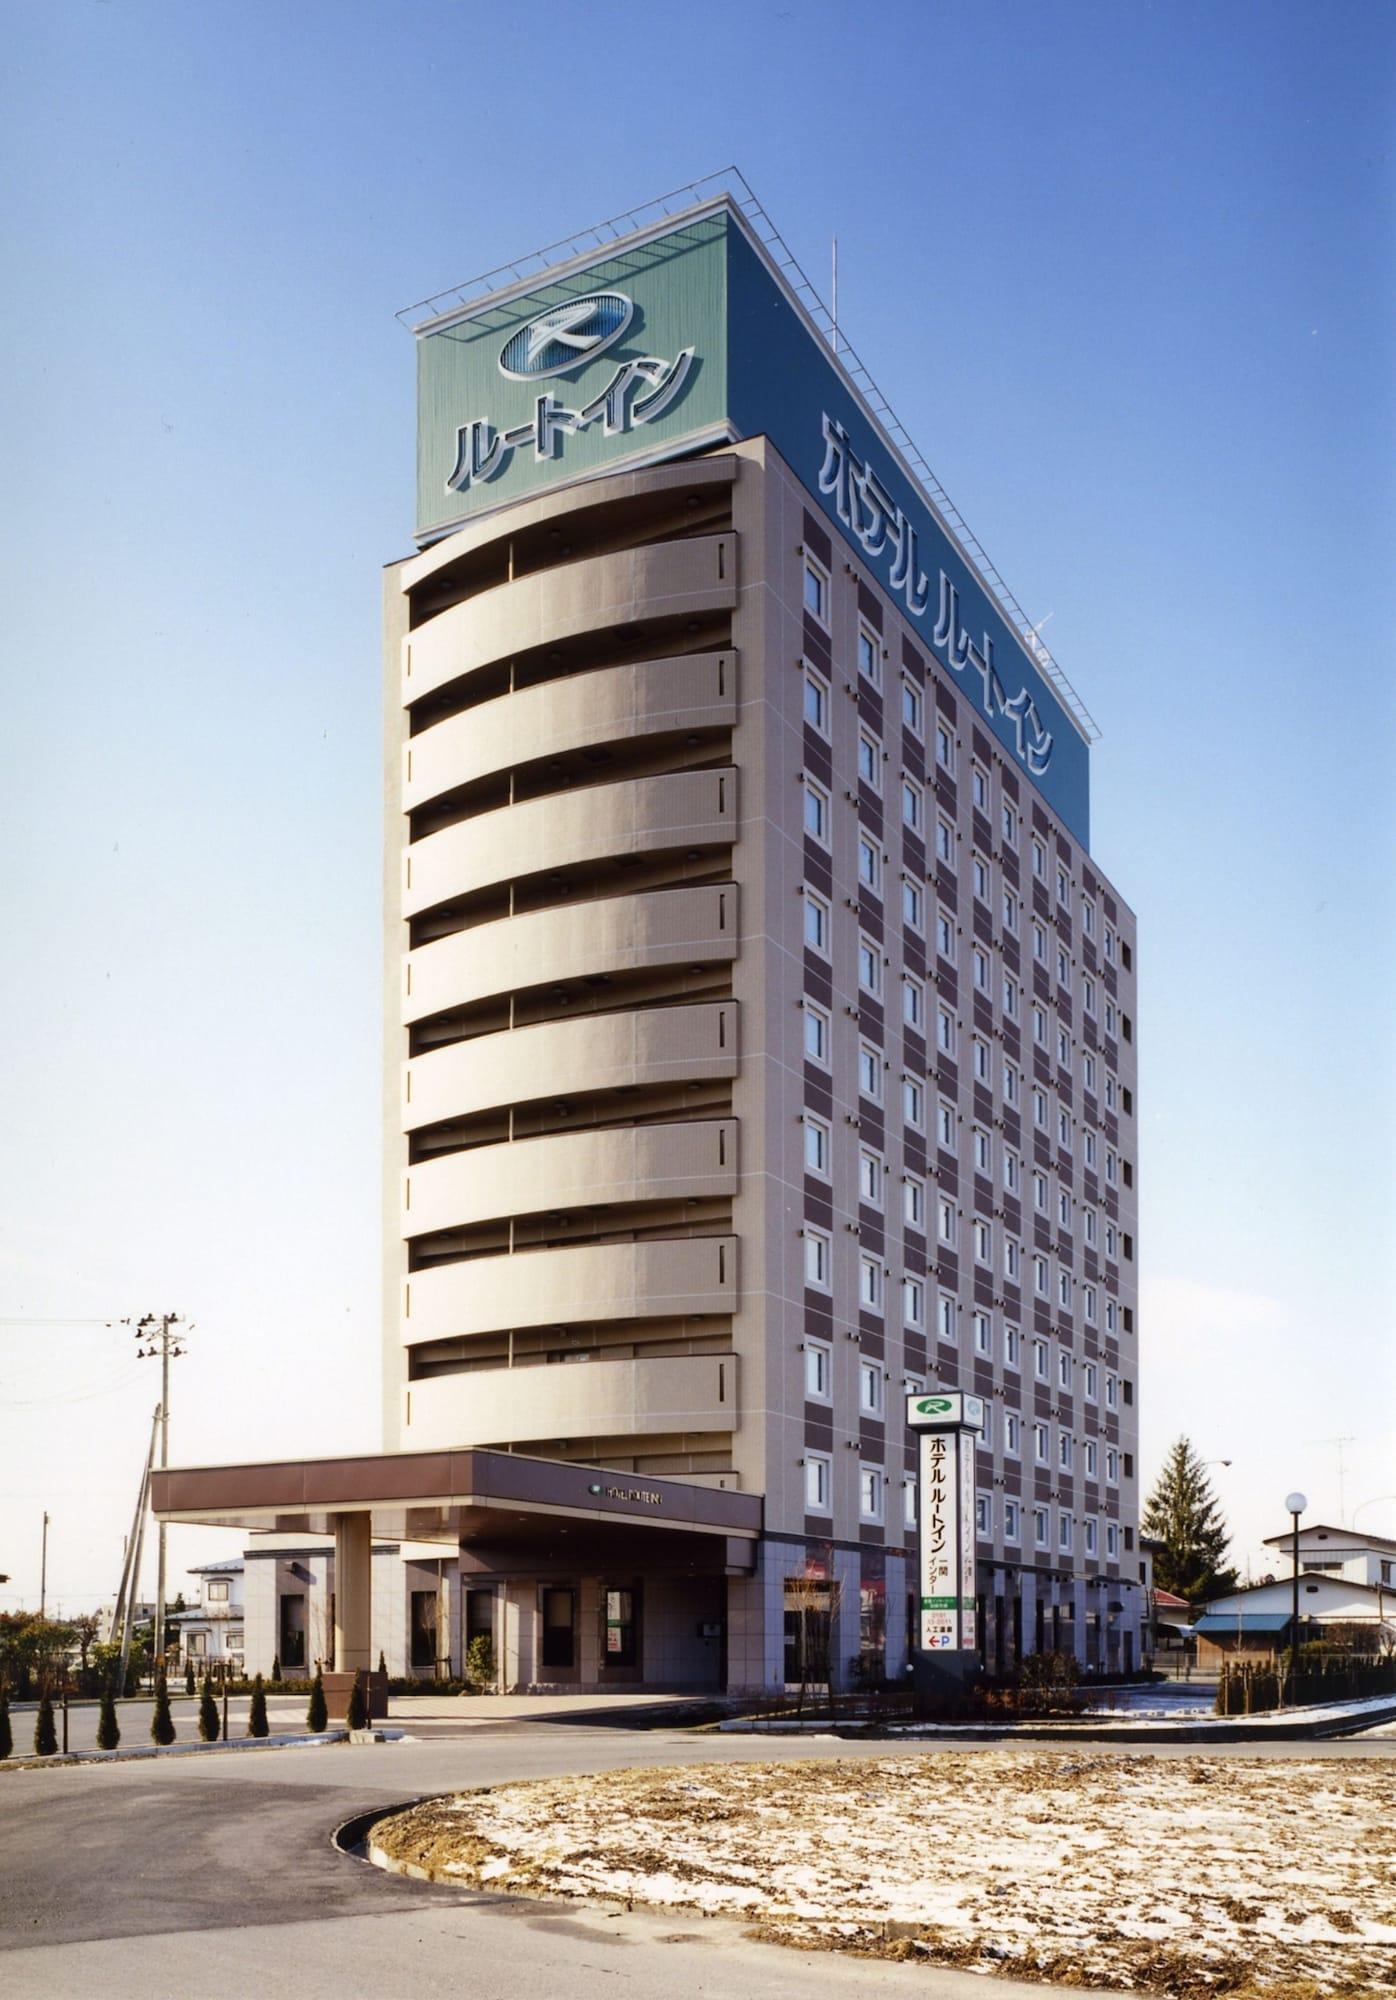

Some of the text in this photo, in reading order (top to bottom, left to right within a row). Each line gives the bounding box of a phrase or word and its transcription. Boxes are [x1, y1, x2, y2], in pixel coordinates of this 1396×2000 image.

[444, 346, 695, 496] ルートイン
[818, 410, 1054, 776] ホテル ルートイン
[930, 1437, 946, 1484] ホテル
[930, 1488, 946, 1553] ルートイン
[928, 1556, 937, 1595] インター
[938, 1559, 949, 1577] 一関
